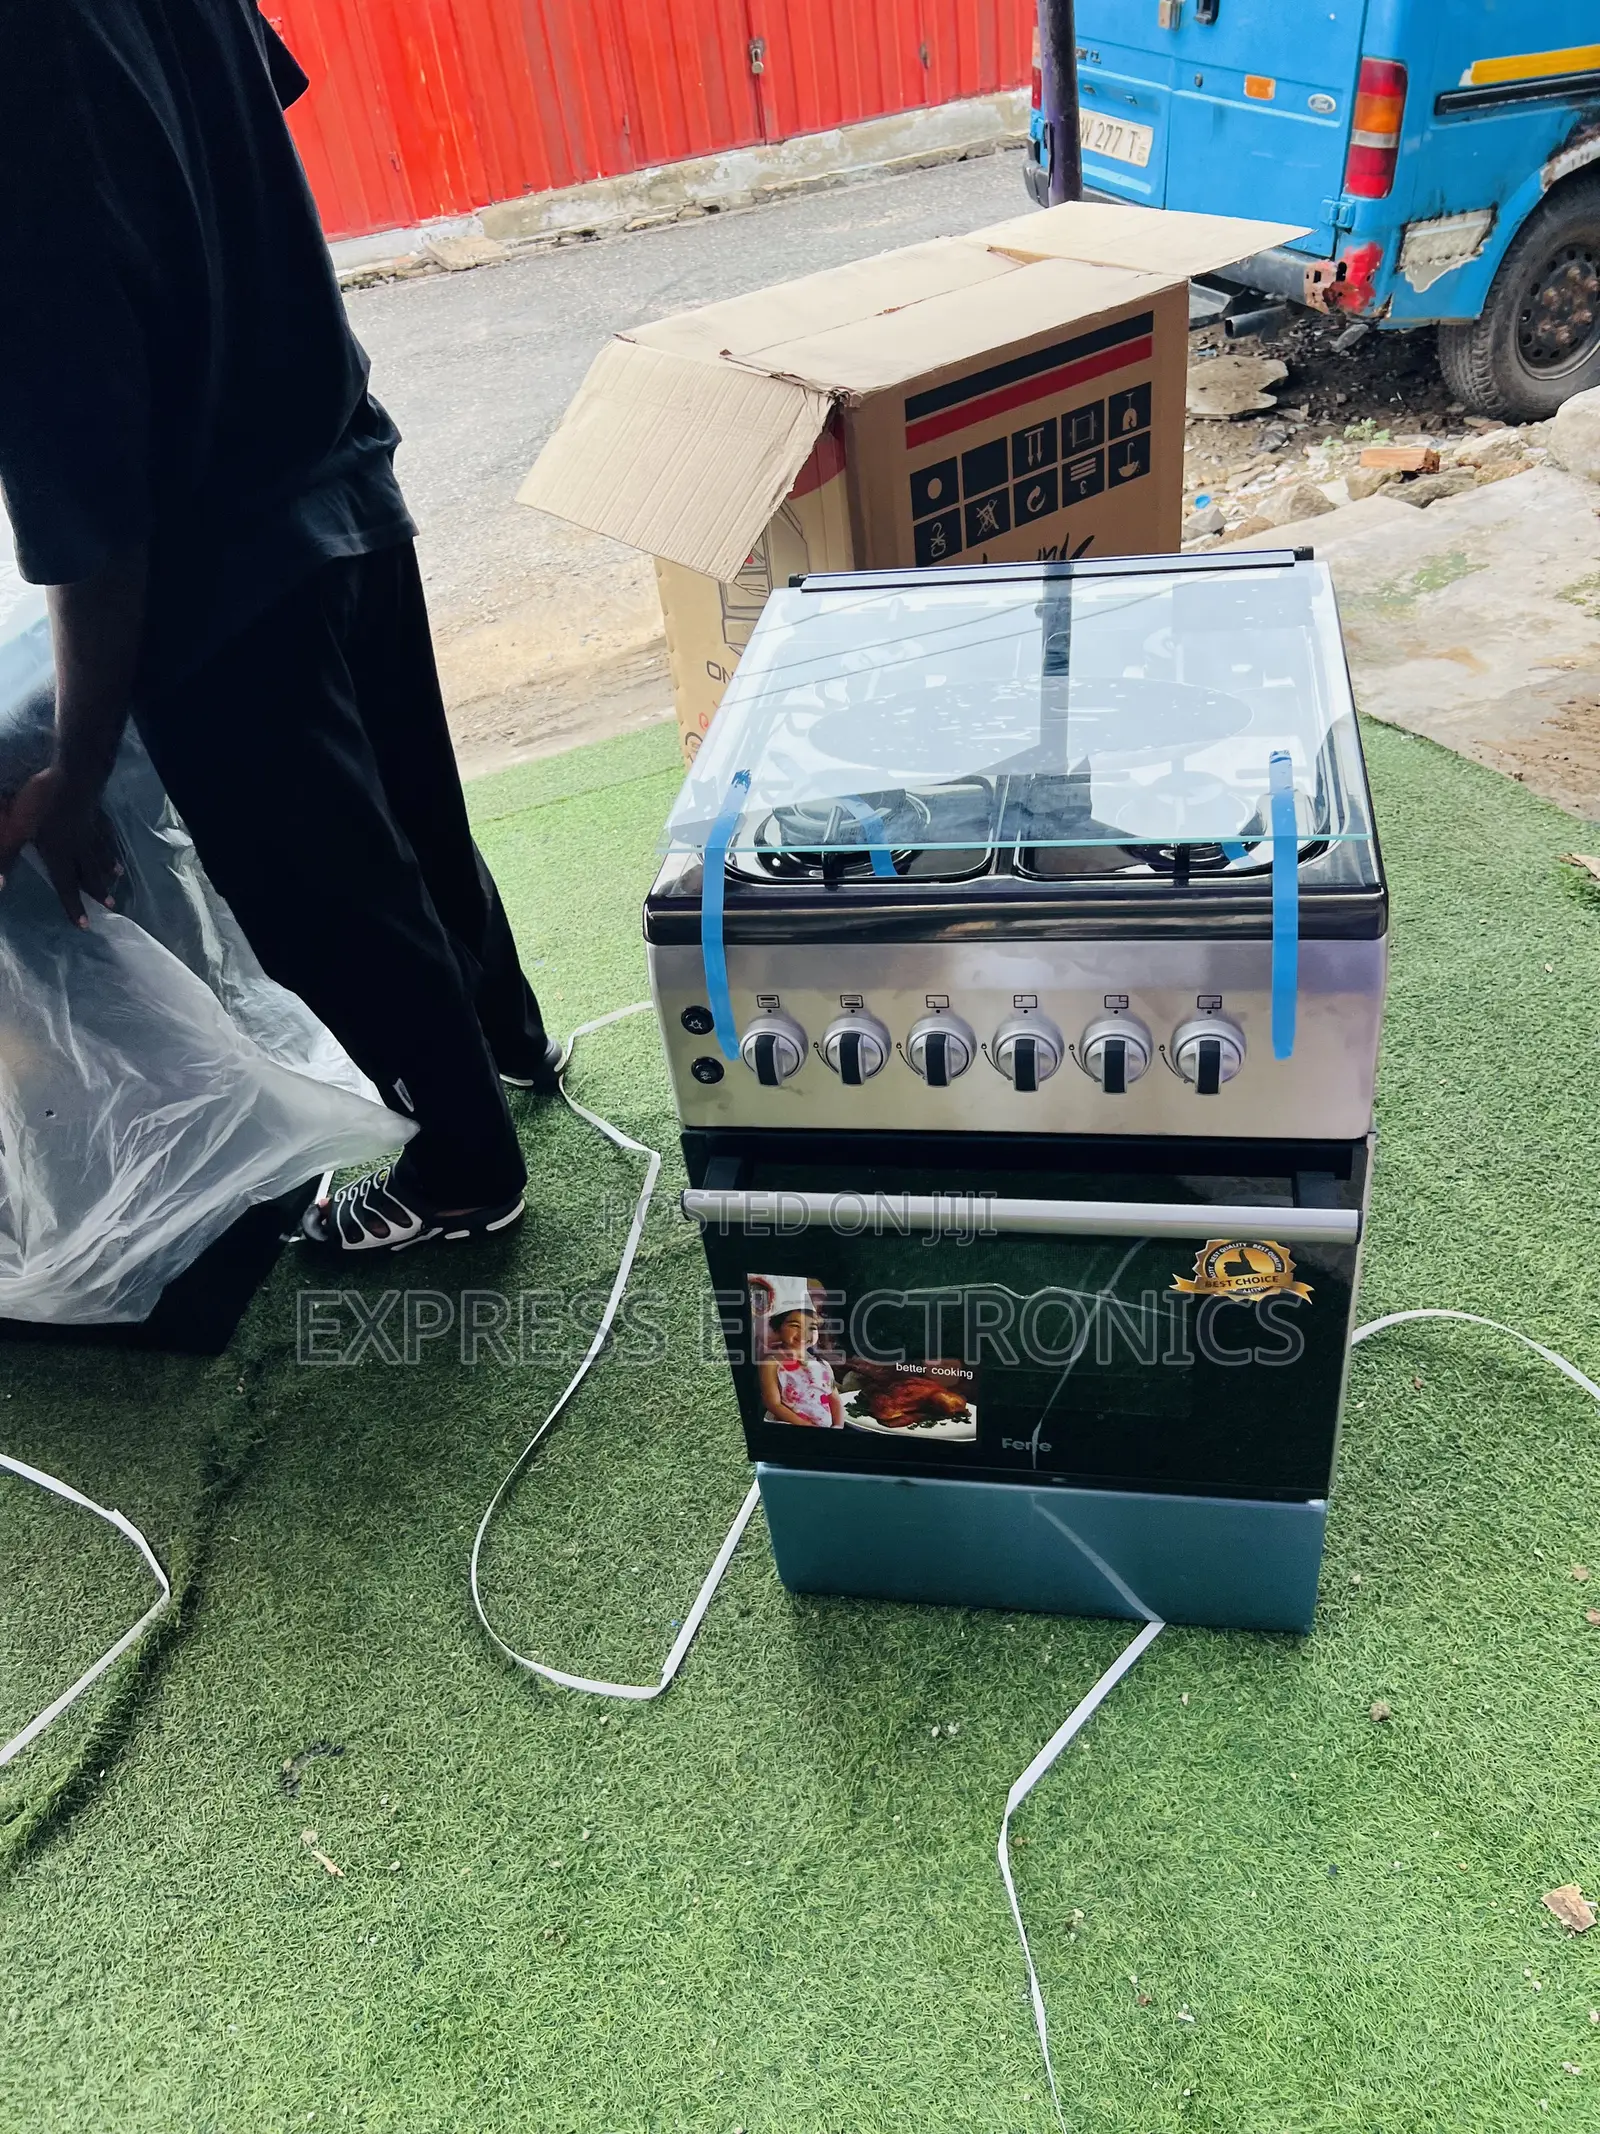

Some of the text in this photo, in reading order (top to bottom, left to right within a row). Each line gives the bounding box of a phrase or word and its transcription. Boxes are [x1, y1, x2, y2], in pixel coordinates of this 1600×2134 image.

[1095, 122, 1123, 154] 277
[1128, 130, 1139, 158] T
[1205, 1275, 1279, 1288] BEST CHOICE
[896, 1362, 974, 1380] better cooking
